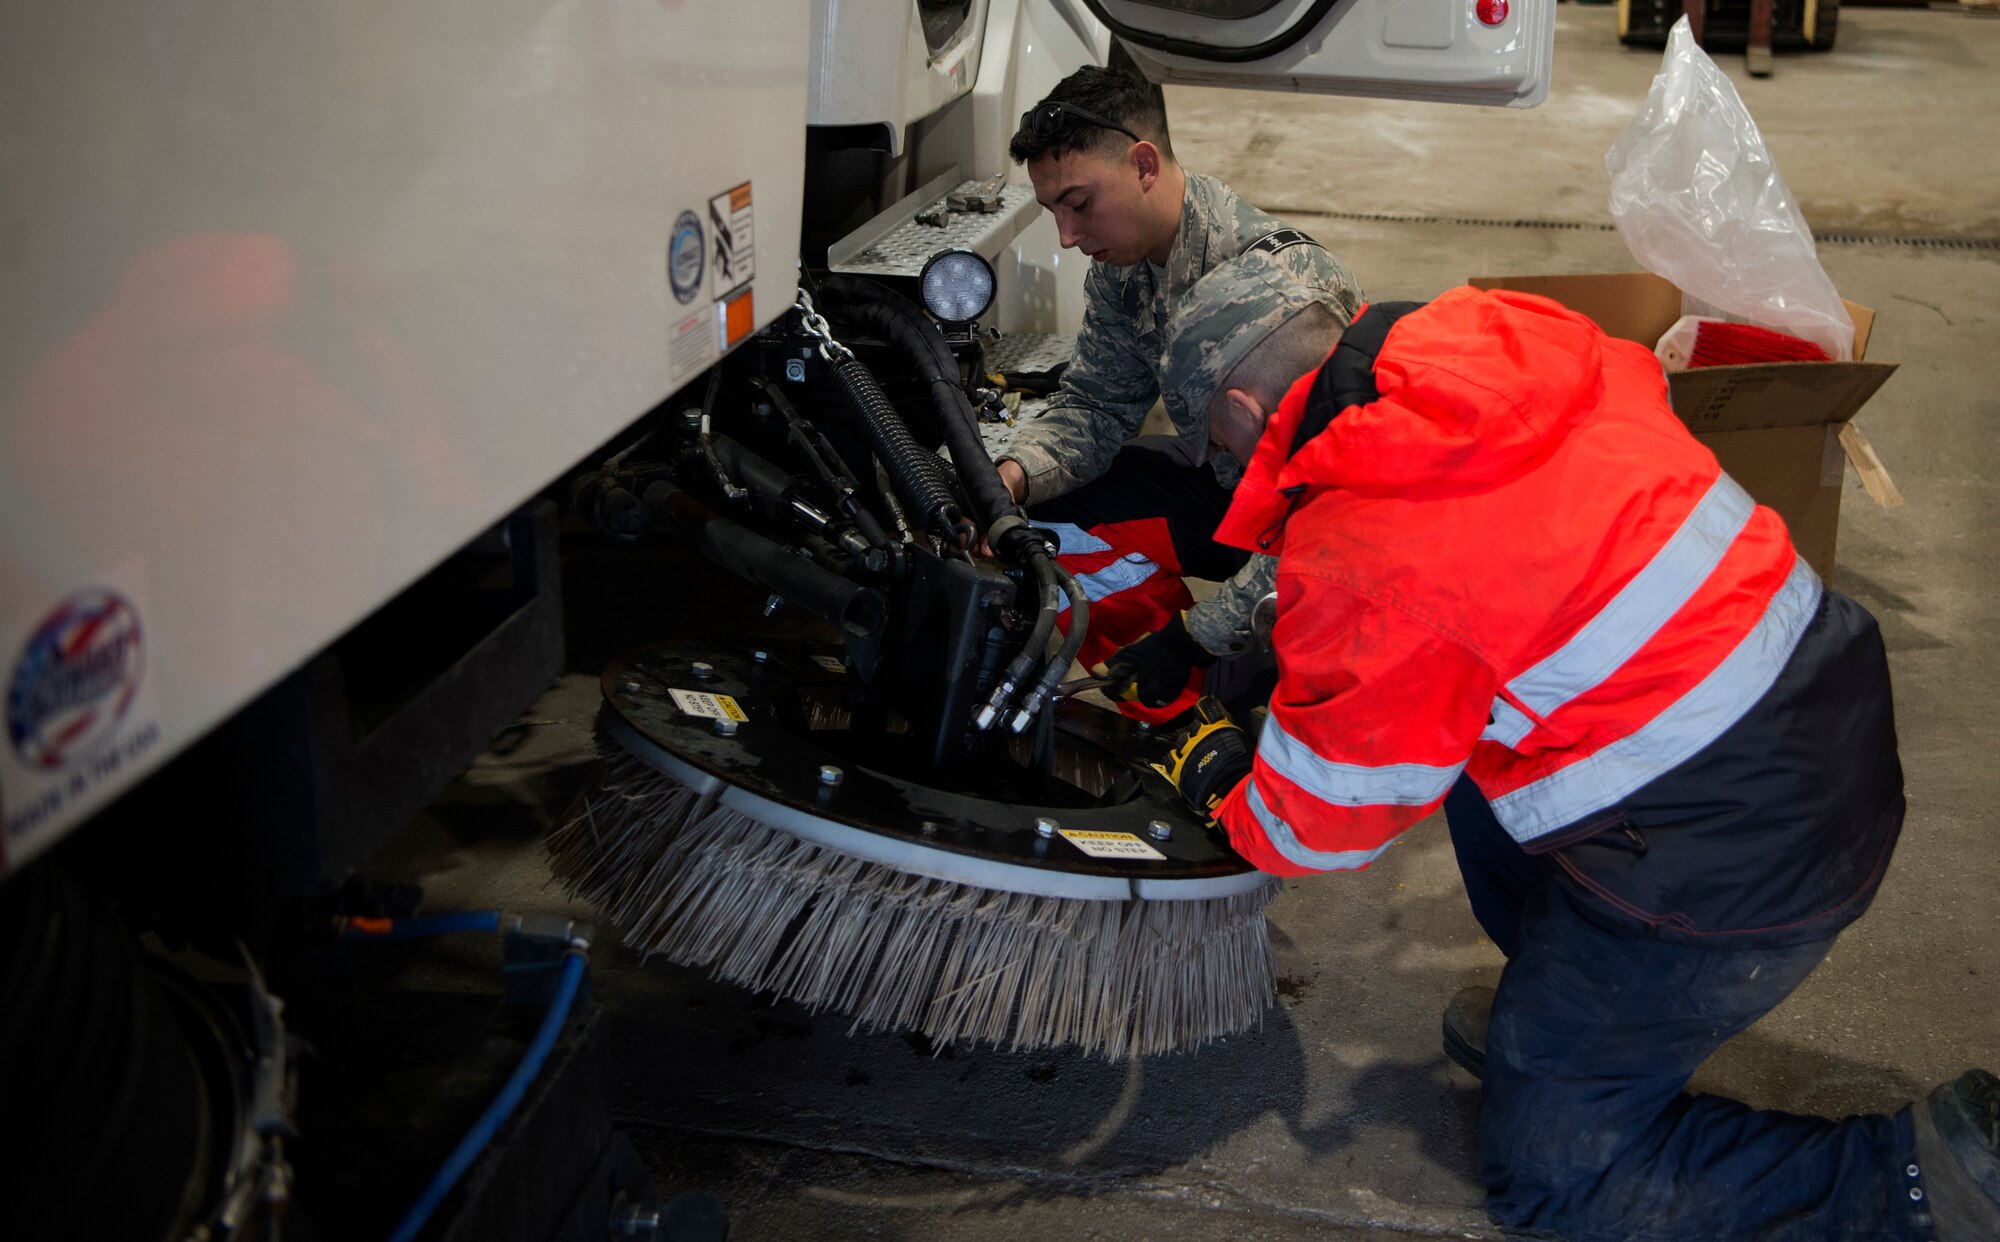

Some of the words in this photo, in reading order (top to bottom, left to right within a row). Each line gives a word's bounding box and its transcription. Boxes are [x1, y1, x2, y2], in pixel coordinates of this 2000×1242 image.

[689, 700, 705, 713] STEP
[699, 695, 714, 707] KEEP
[722, 700, 740, 719] CAUTION
